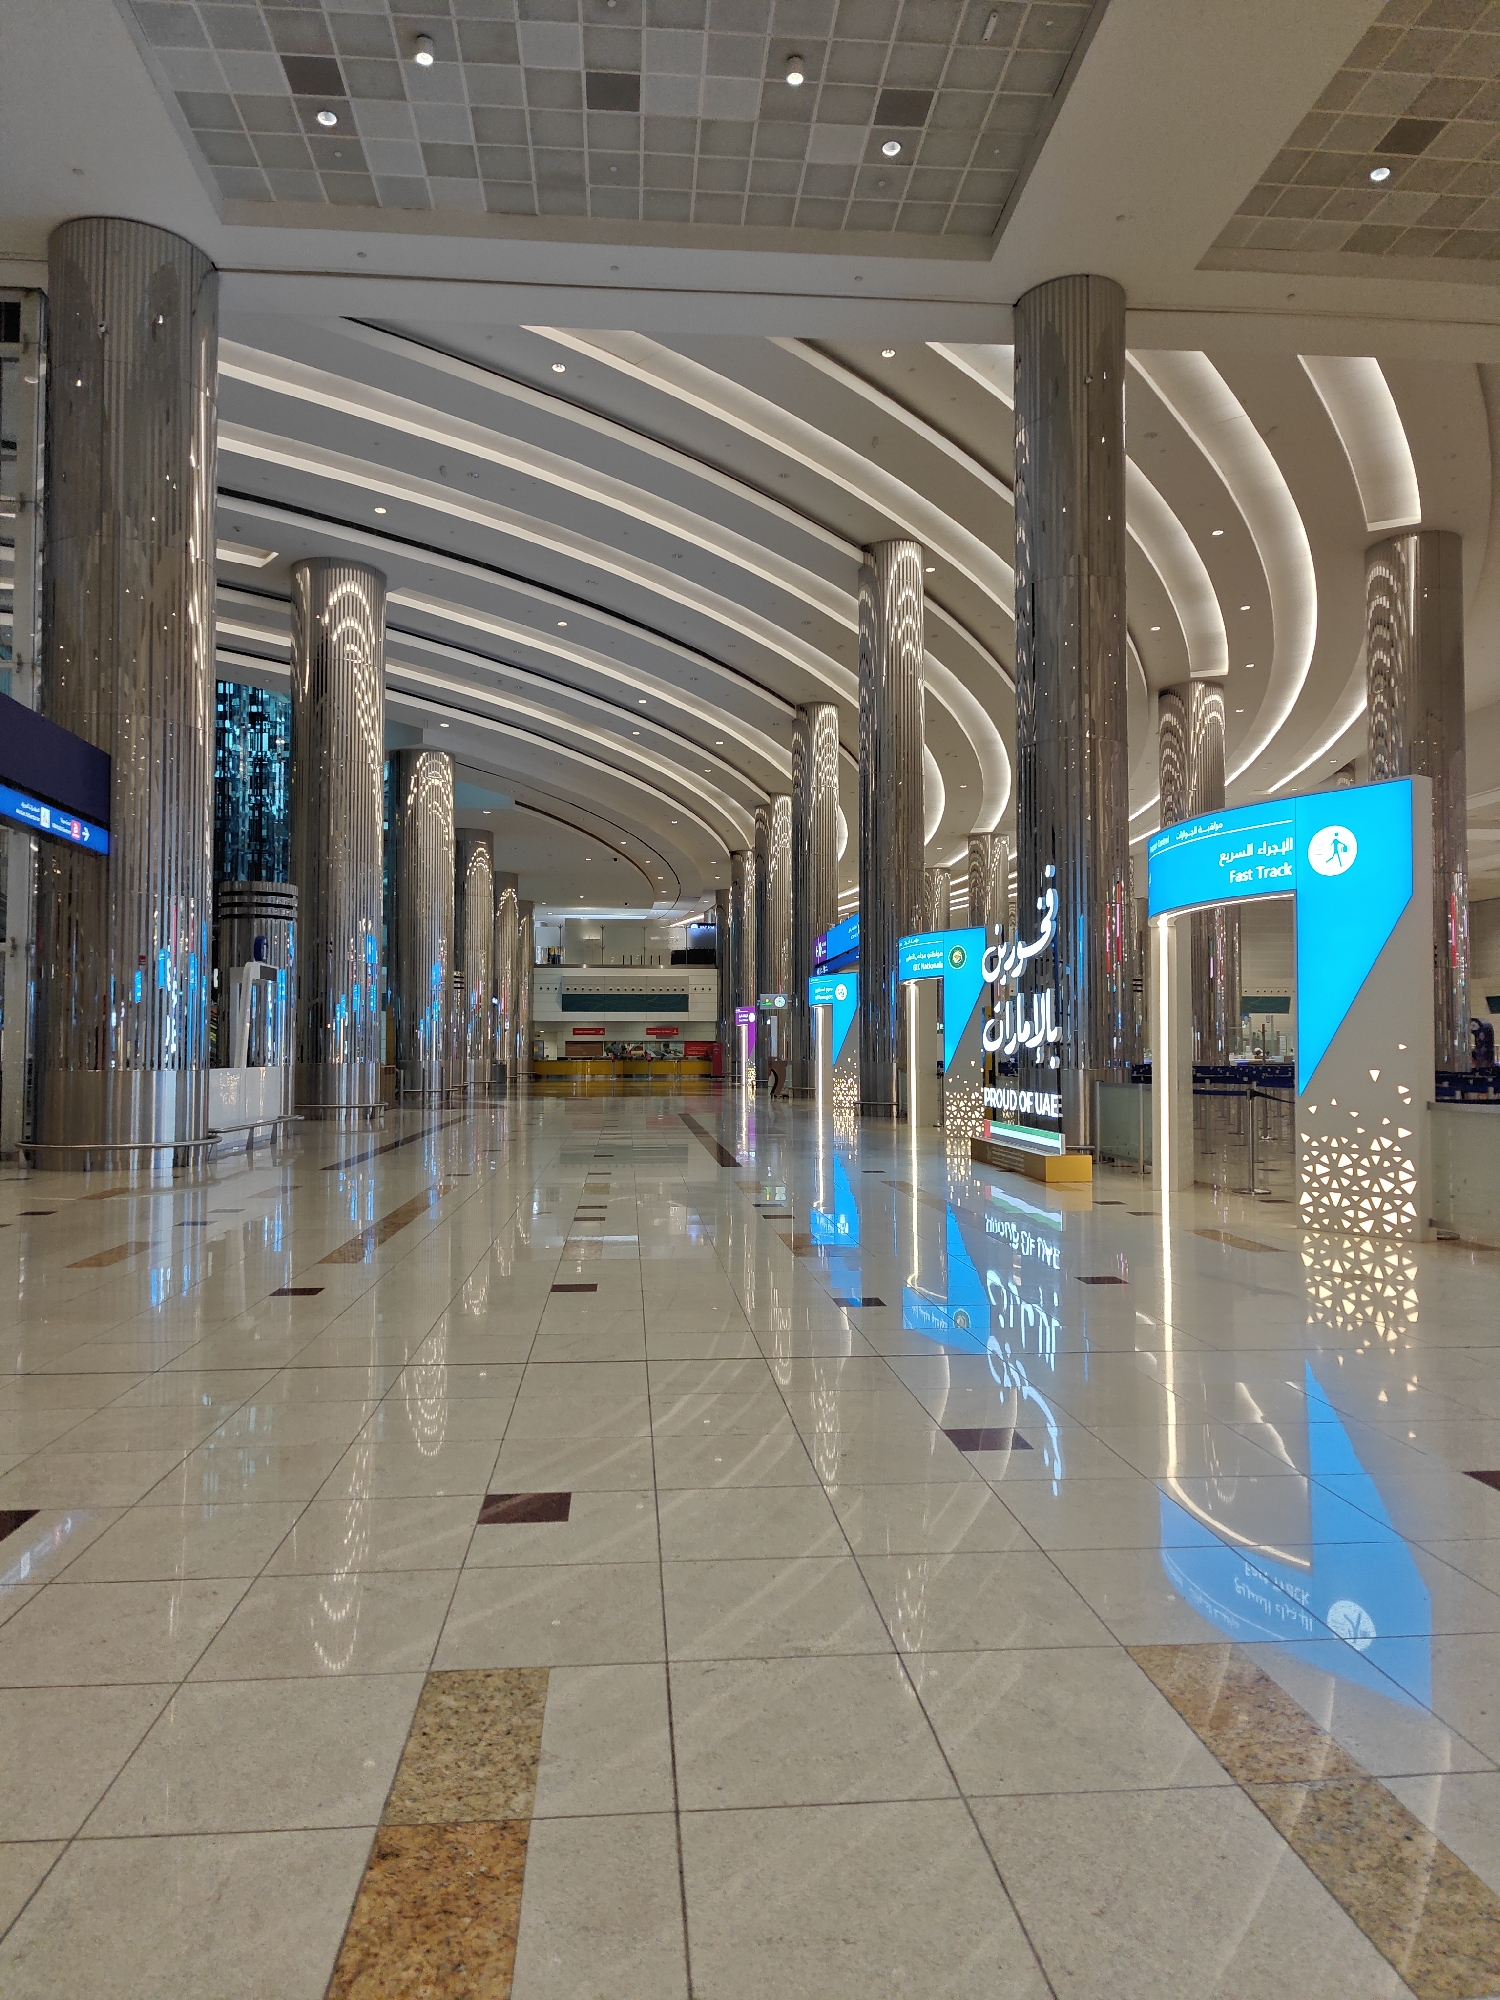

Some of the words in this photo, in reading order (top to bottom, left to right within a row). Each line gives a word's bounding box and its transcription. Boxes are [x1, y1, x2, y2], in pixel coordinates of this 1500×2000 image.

[1218, 842, 1254, 868] السريع
[1256, 836, 1294, 857] الإجراء
[1229, 868, 1254, 884] Fast
[1255, 861, 1293, 880] Track
[982, 864, 1059, 985] فخورين
[984, 1087, 1018, 1111] PROUD
[1018, 1090, 1034, 1114] OF
[1034, 1091, 1061, 1118] UAE
